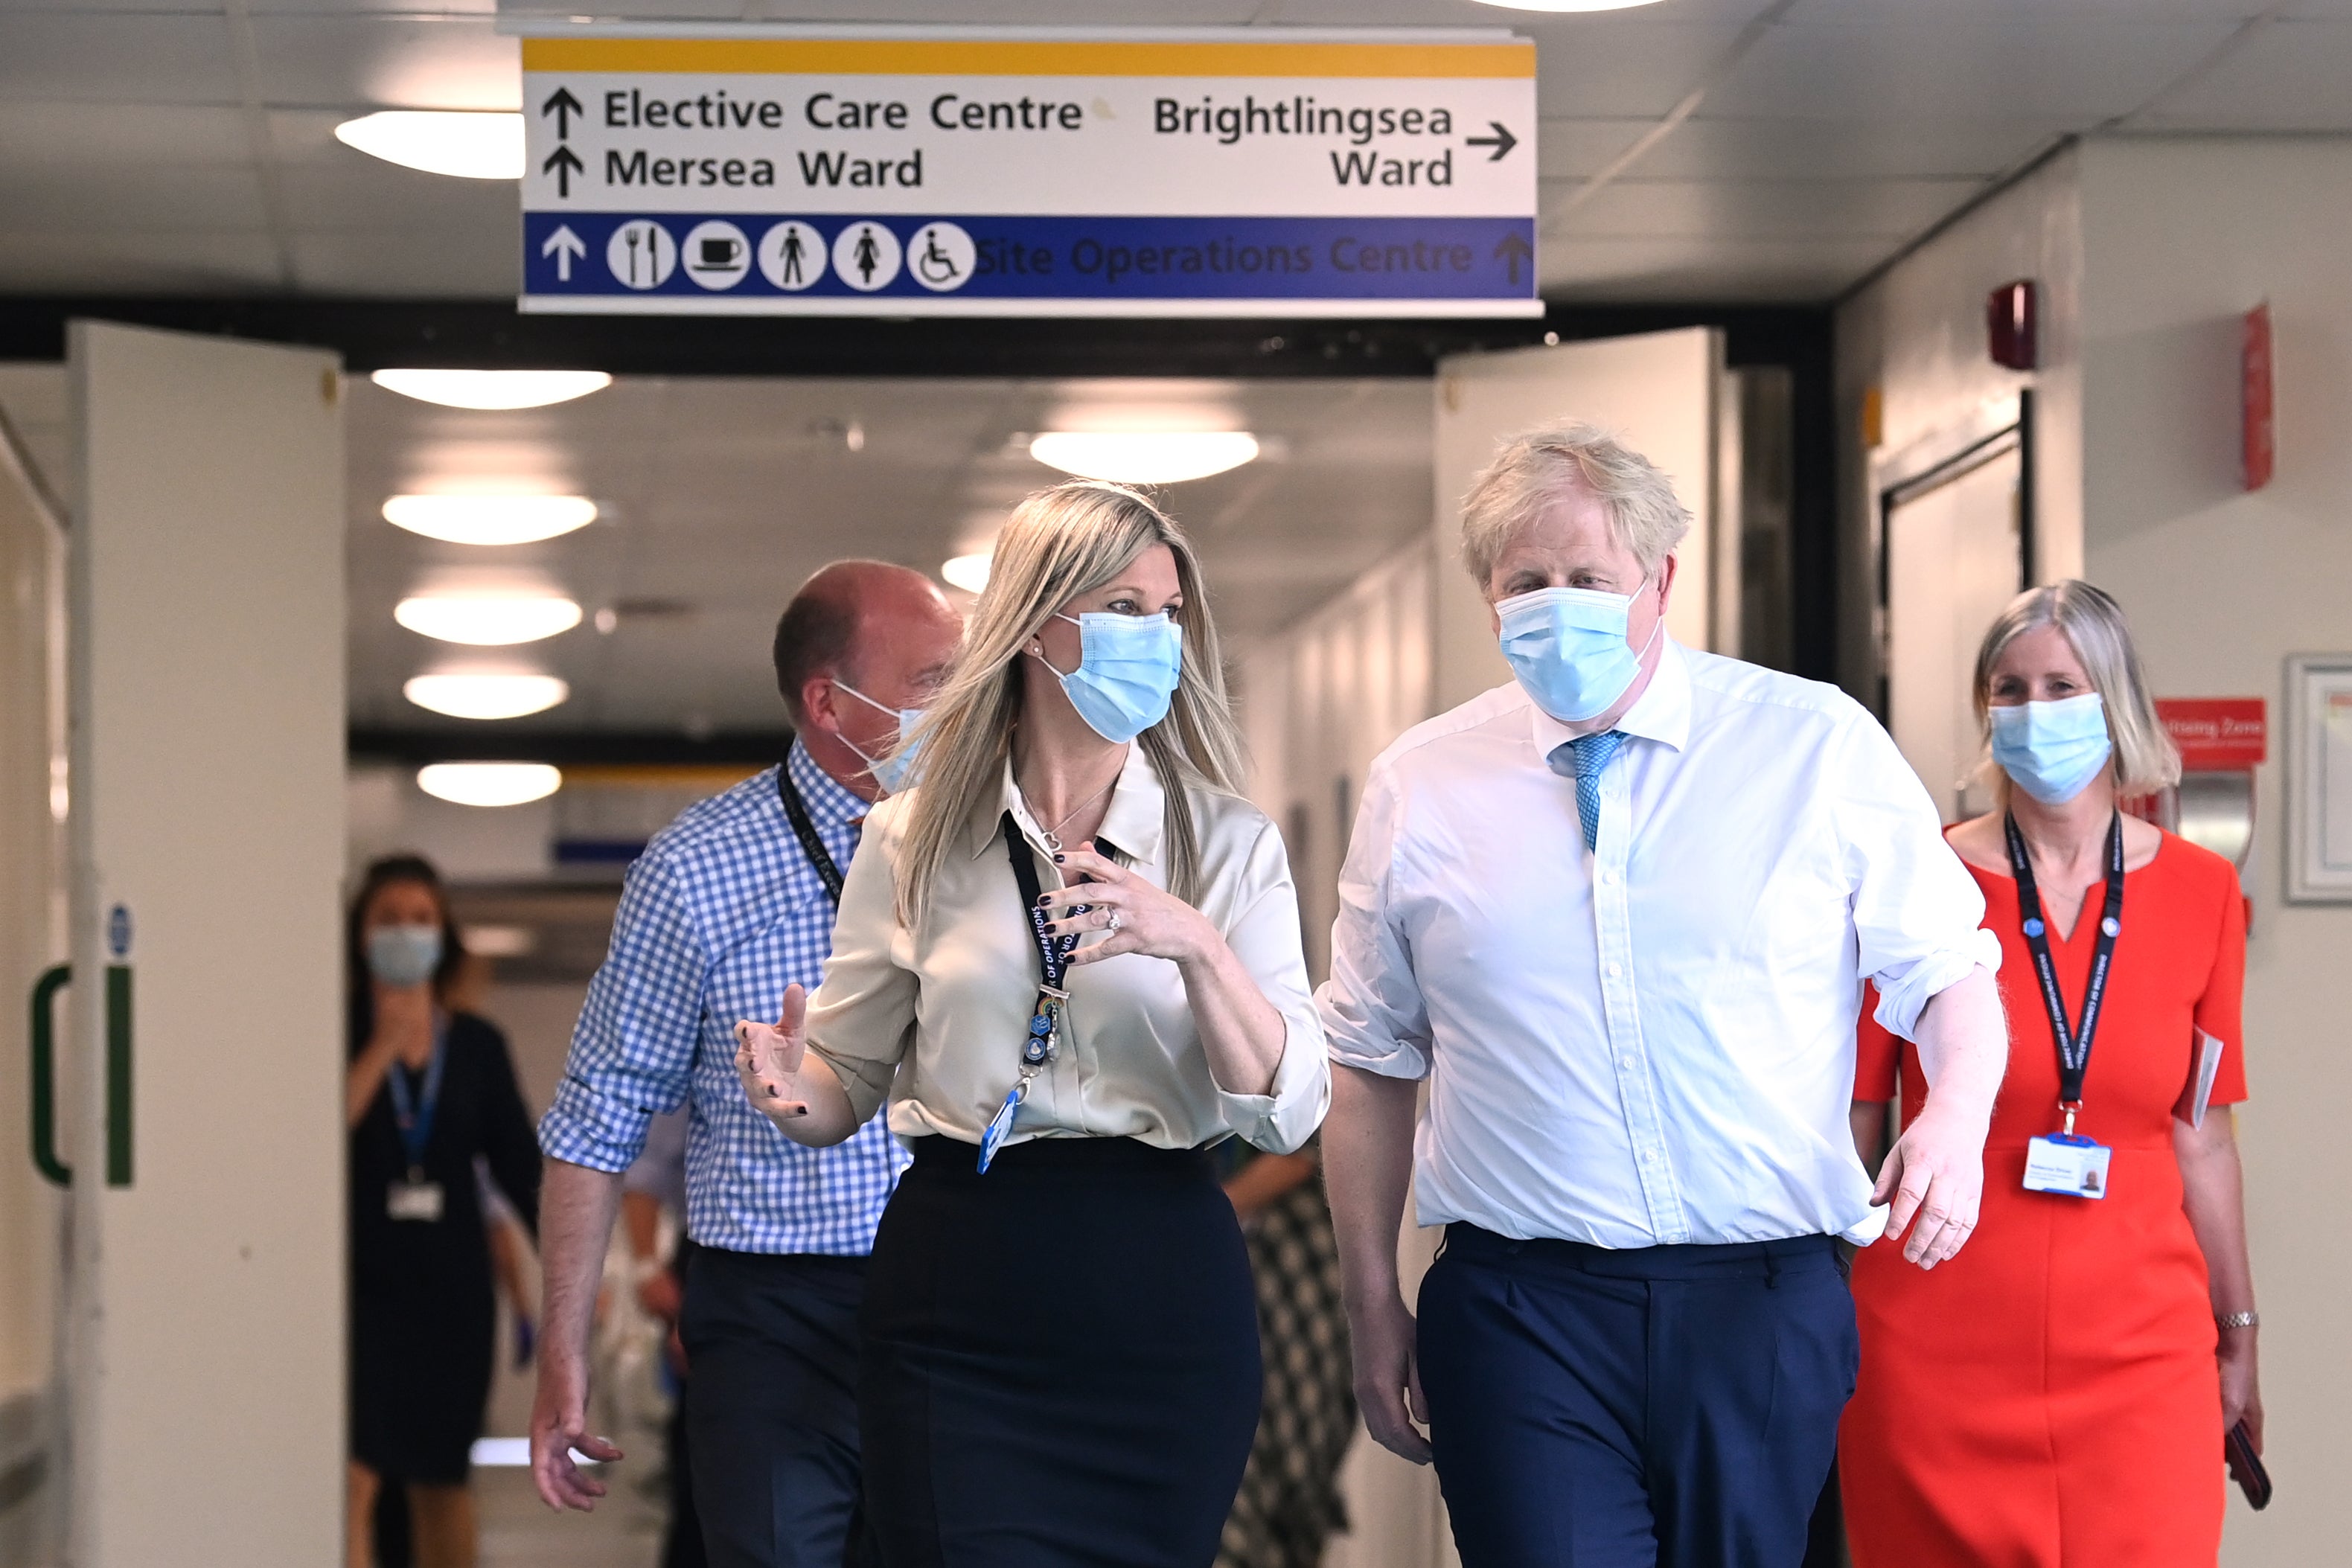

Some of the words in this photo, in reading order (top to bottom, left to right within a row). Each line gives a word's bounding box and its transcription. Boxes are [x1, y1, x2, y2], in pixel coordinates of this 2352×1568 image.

[604, 89, 783, 128] Elective
[805, 93, 908, 129] Care
[930, 94, 1082, 129] Centre
[1154, 97, 1451, 144] Brightlingsea
[606, 150, 775, 186] Mersea
[797, 149, 922, 187] Ward
[1331, 150, 1451, 185] Ward
[976, 237, 1053, 275] Site
[1070, 234, 1312, 284] Operations
[1331, 236, 1474, 272] Centre
[1032, 906, 1054, 963] OPERATIONS
[1047, 964, 1056, 978] OF
